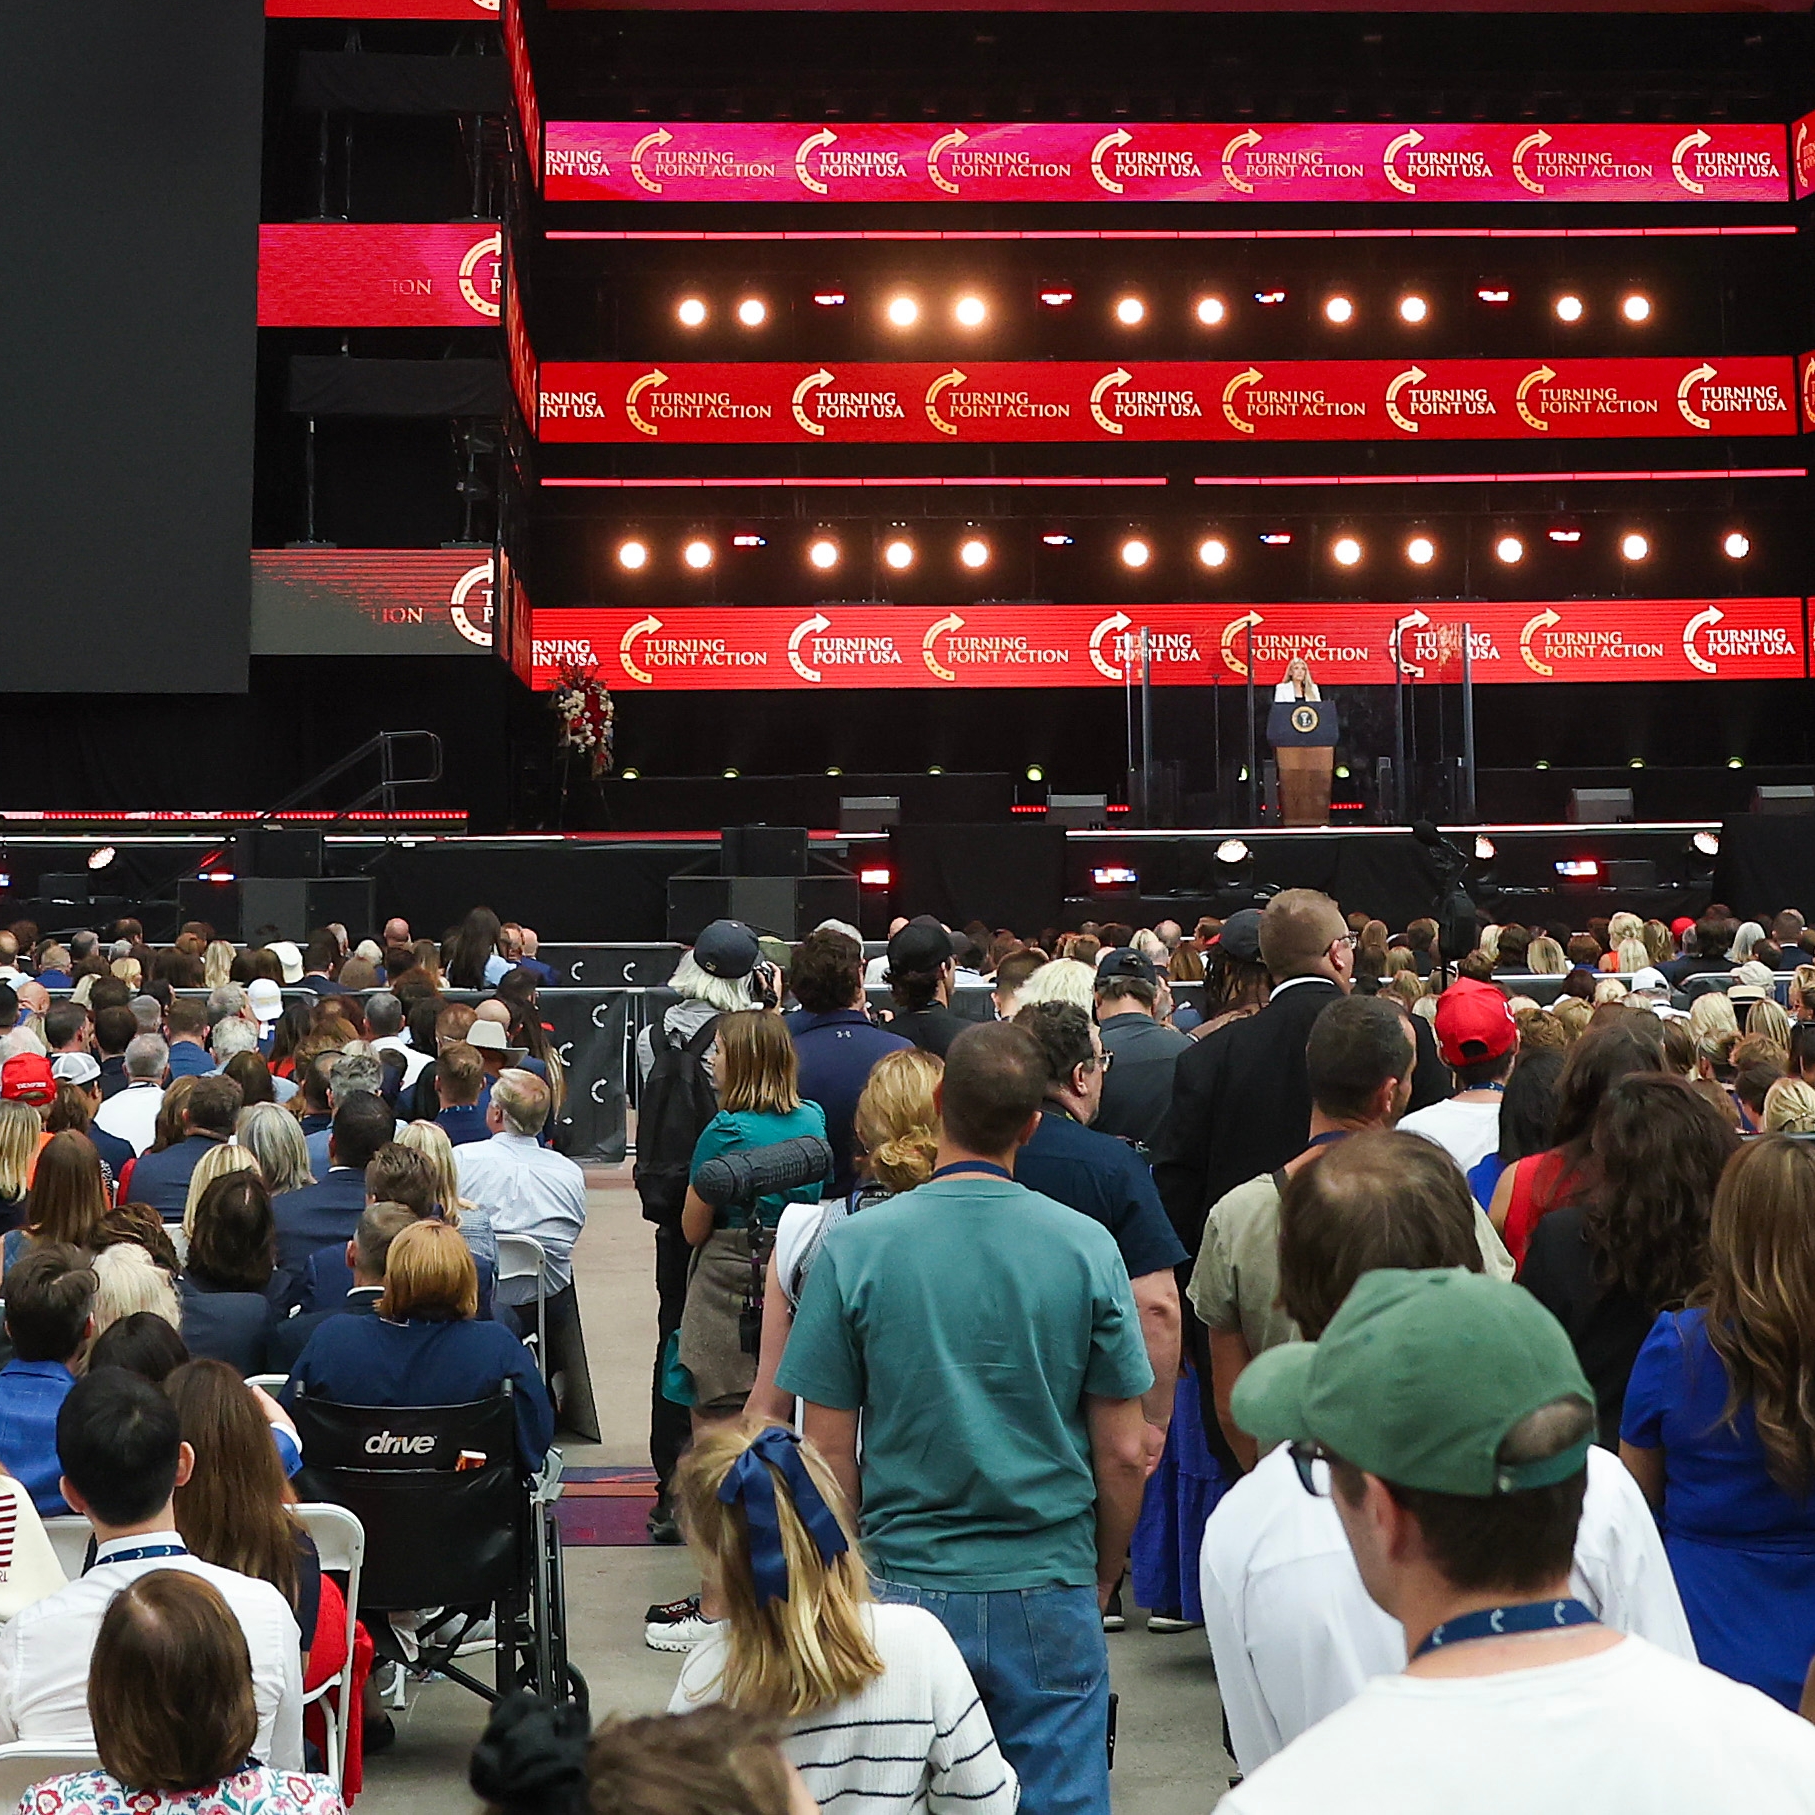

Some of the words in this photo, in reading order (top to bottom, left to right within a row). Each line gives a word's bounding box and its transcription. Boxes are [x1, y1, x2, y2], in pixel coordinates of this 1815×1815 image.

[546, 150, 602, 164] RNING
[654, 151, 734, 164] TURNING
[819, 151, 899, 165] TURNING
[951, 151, 1030, 165] TURNING
[1114, 151, 1193, 165] TURNING
[1245, 151, 1323, 165] TURNING
[1405, 151, 1484, 165] TURNING
[1535, 152, 1613, 165] TURNING
[1694, 152, 1772, 165] TURNING
[579, 163, 611, 176] USA
[656, 164, 709, 177] POINT
[711, 164, 775, 177] ACTION
[821, 164, 874, 177] POINT
[876, 164, 908, 177] USA
[952, 164, 1005, 177] POINT
[1007, 164, 1072, 177] ACTION
[1116, 164, 1169, 177] POINT
[1170, 164, 1203, 177] USA
[1247, 164, 1299, 177] POINT
[1301, 164, 1365, 177] ACTION
[1407, 164, 1460, 177] POINT
[1462, 164, 1494, 177] USA
[1537, 165, 1589, 178] POINT
[1590, 165, 1654, 178] ACTION
[1696, 165, 1748, 178] POINT
[1750, 165, 1781, 178] USA
[539, 391, 598, 405] RNING
[650, 391, 730, 406] TURNING
[816, 391, 897, 406] TURNING
[949, 391, 1030, 406] TURNING
[1114, 391, 1194, 405] TURNING
[1246, 390, 1325, 404] TURNING
[1409, 389, 1489, 403] TURNING
[1539, 387, 1618, 401] TURNING
[1700, 385, 1779, 401] TURNING
[573, 405, 606, 418] USA
[651, 405, 705, 419] POINT
[707, 405, 773, 419] ACTION
[817, 405, 871, 418] POINT
[872, 405, 906, 418] USA
[951, 405, 1004, 418] POINT
[1006, 405, 1071, 418] ACTION
[1115, 404, 1168, 417] POINT
[1169, 404, 1203, 417] USA
[1247, 403, 1300, 416] POINT
[1302, 403, 1367, 416] ACTION
[1411, 402, 1464, 415] POINT
[1465, 402, 1497, 415] USA
[1540, 400, 1593, 414] POINT
[1595, 400, 1659, 414] ACTION
[1701, 399, 1754, 413] POINT
[1756, 399, 1789, 413] USA
[1543, 631, 1624, 646] TURNING
[1705, 628, 1788, 643] TURNING
[532, 639, 591, 654] RNING
[643, 638, 725, 653] TURNING
[811, 636, 893, 651] TURNING
[946, 636, 1028, 650] TURNING
[1707, 642, 1760, 656] POINT
[1762, 642, 1797, 656] USA
[645, 652, 699, 666] POINT
[700, 652, 768, 666] ACTION
[813, 650, 868, 665] POINT
[869, 650, 904, 665] USA
[947, 649, 1001, 664] POINT
[1002, 649, 1070, 664] ACTION
[1169, 648, 1202, 662] USA
[1304, 647, 1370, 662] ACTION
[1468, 646, 1501, 661] USA
[1545, 645, 1598, 659] POINT
[1600, 645, 1665, 659] ACTION
[566, 652, 600, 667] USA
[364, 1430, 435, 1454] drive
